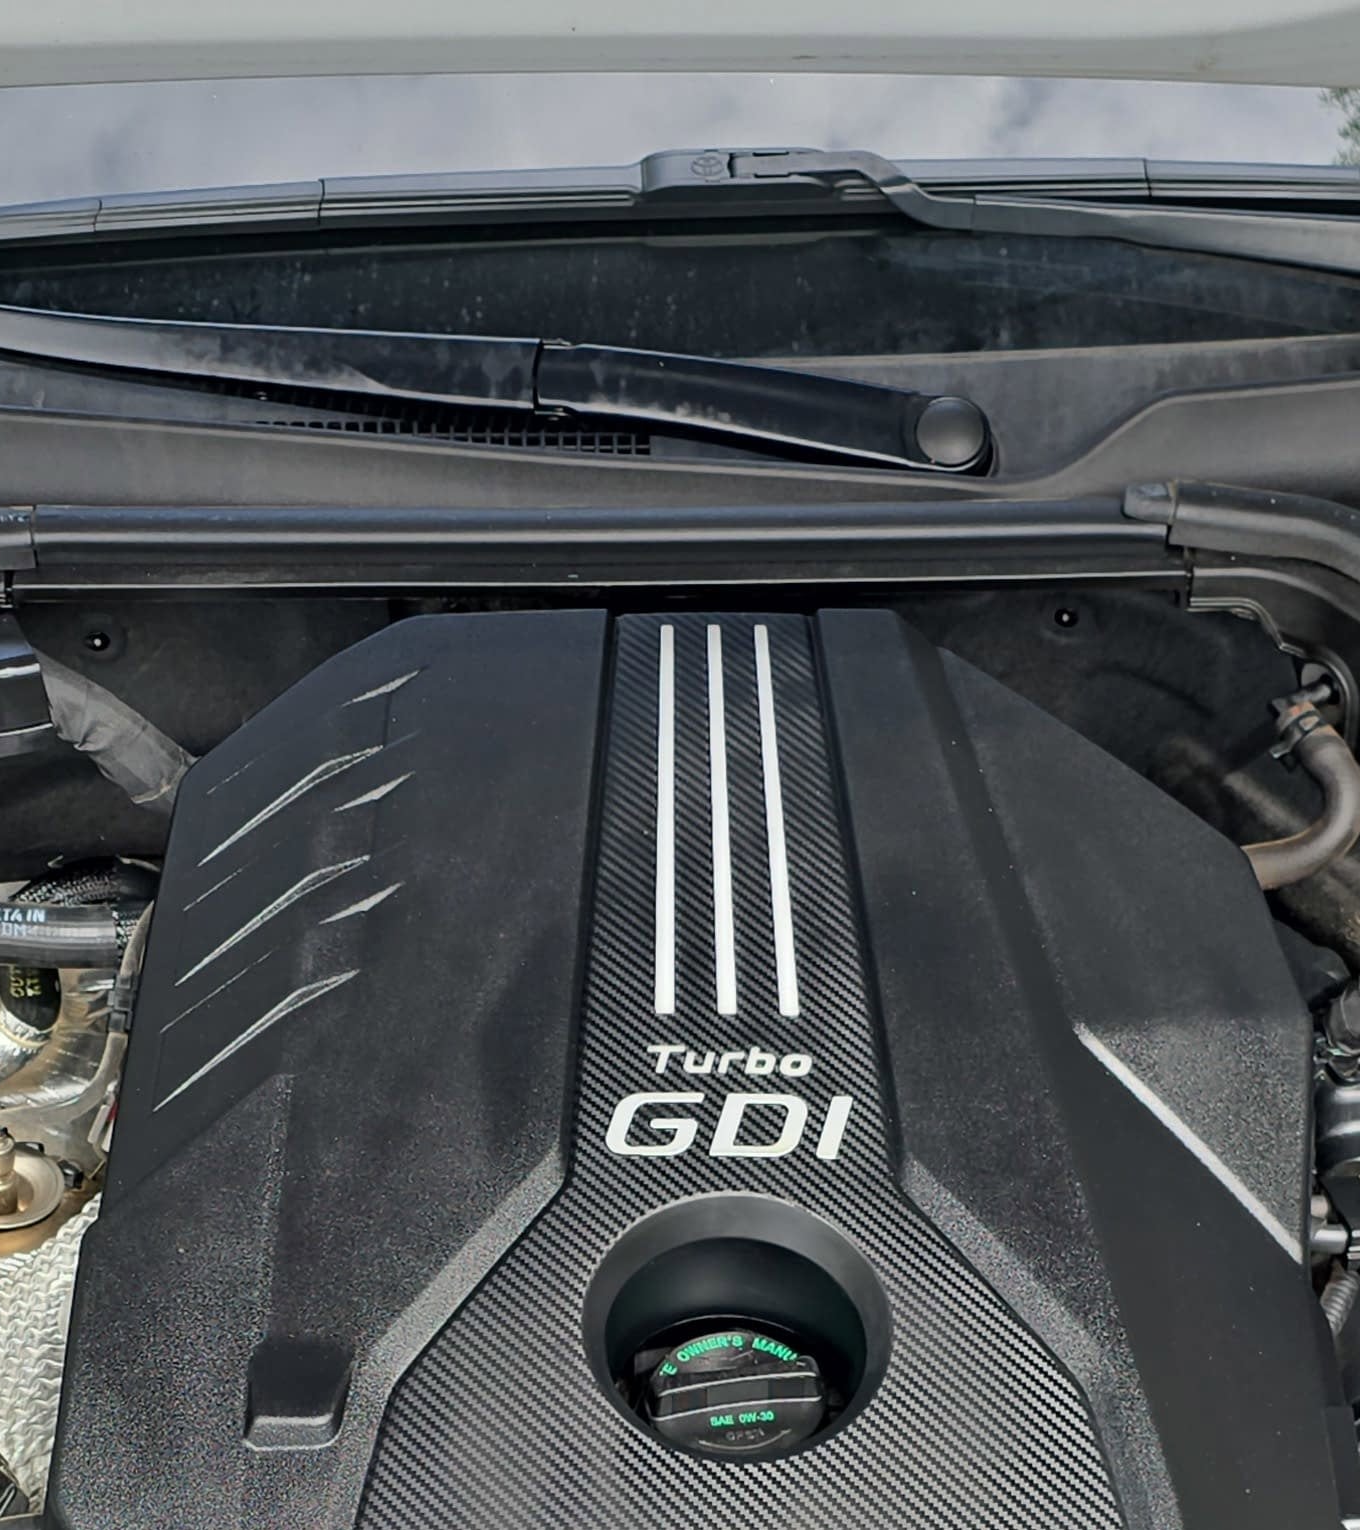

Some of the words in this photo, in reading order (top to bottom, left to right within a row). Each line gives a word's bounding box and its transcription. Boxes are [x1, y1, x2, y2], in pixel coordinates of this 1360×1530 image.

[25, 908, 45, 923] IN
[646, 1044, 813, 1077] Turbo
[605, 1091, 853, 1160] GDI
[676, 1335, 744, 1363] OWNER'S
[710, 1415, 735, 1427] SAE
